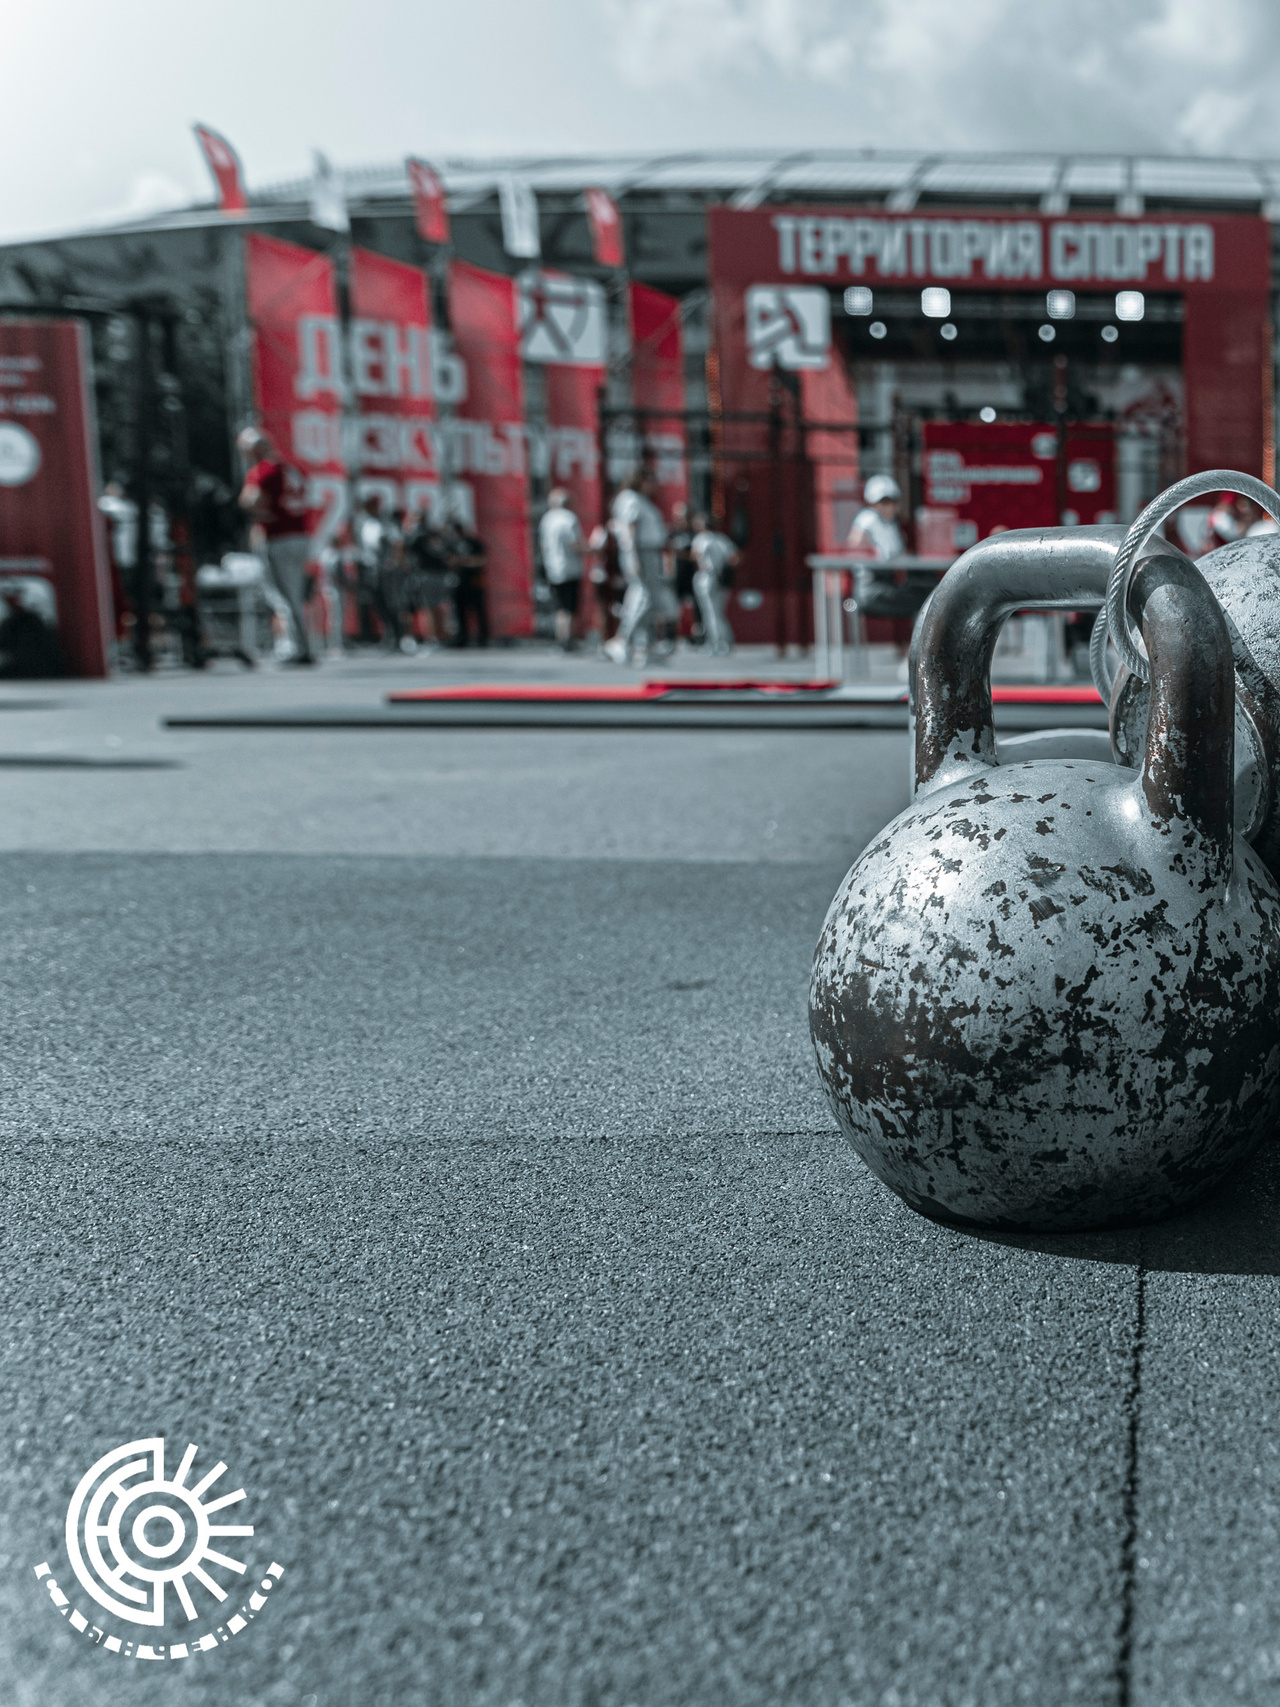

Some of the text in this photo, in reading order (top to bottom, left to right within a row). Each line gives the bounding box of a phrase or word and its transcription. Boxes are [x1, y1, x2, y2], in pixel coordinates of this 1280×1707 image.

[774, 214, 1215, 282] ТЕРРИТОРИЯ СПОРТА
[294, 315, 468, 401] ДЕНЬ
